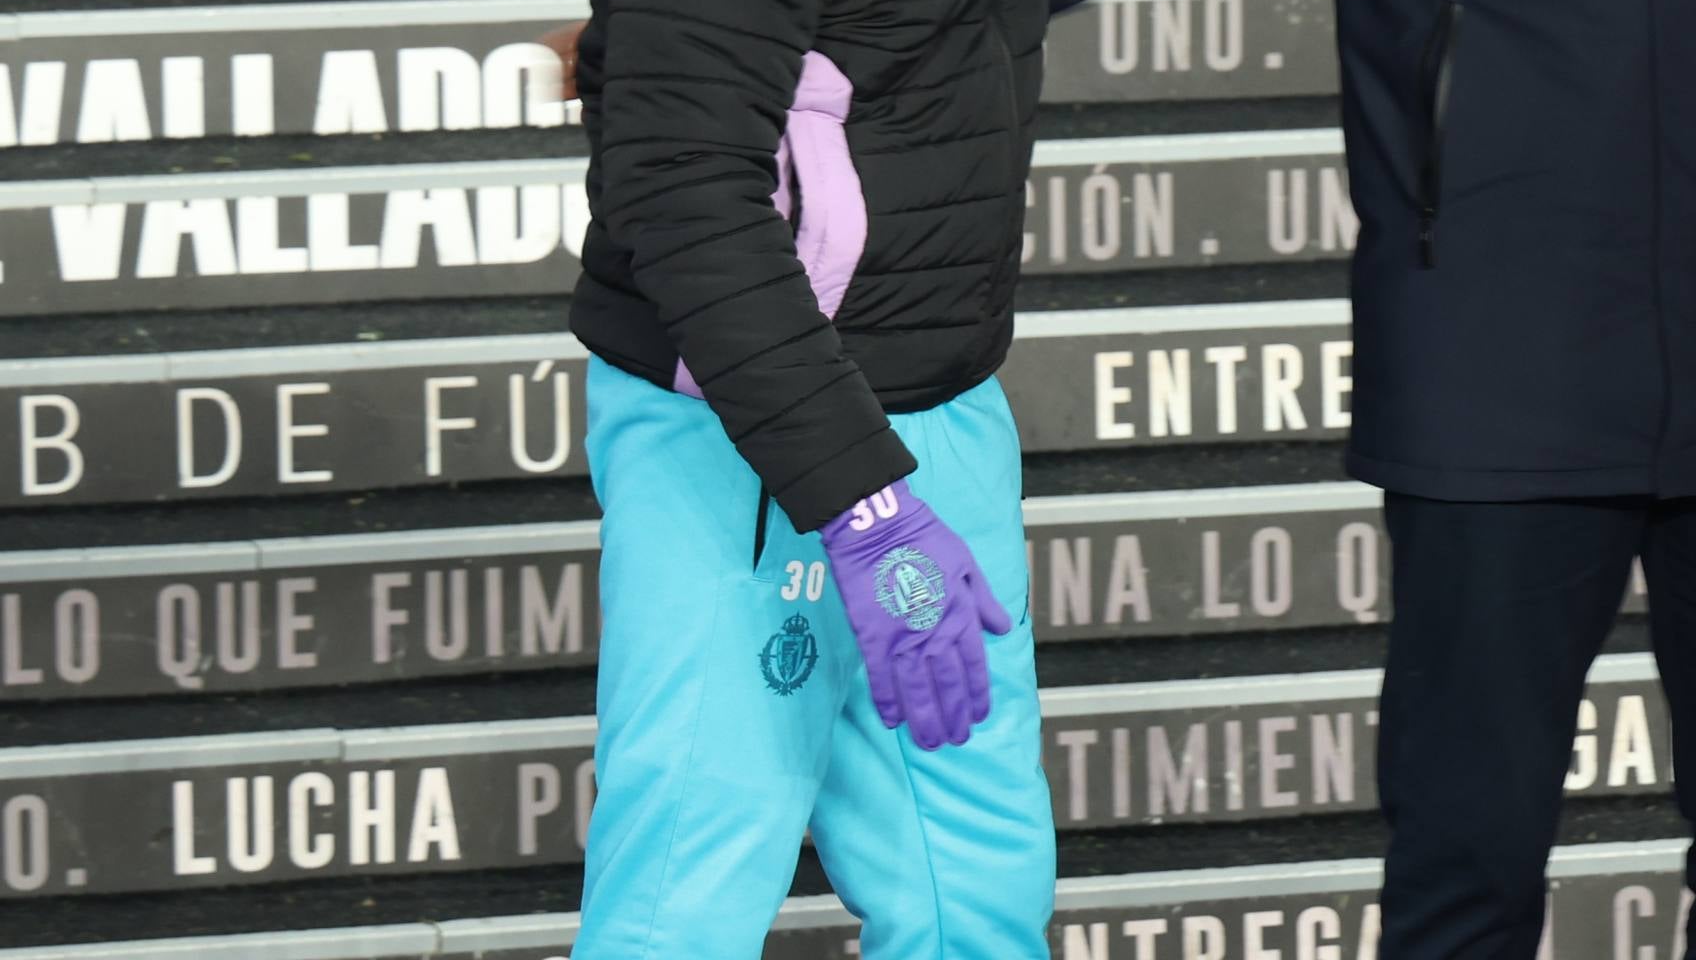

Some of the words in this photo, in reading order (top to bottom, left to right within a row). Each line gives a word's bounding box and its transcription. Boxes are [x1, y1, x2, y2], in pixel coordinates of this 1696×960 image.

[19, 395, 85, 496] B
[176, 382, 334, 489] DE
[424, 359, 572, 477] FÚ
[1094, 340, 1353, 441] ENTRE
[848, 484, 900, 531] 30
[2, 589, 100, 685] LO
[157, 577, 318, 689] QUE
[1202, 525, 1293, 618] LO
[780, 560, 826, 602] 30
[172, 767, 462, 876] LUCHA
